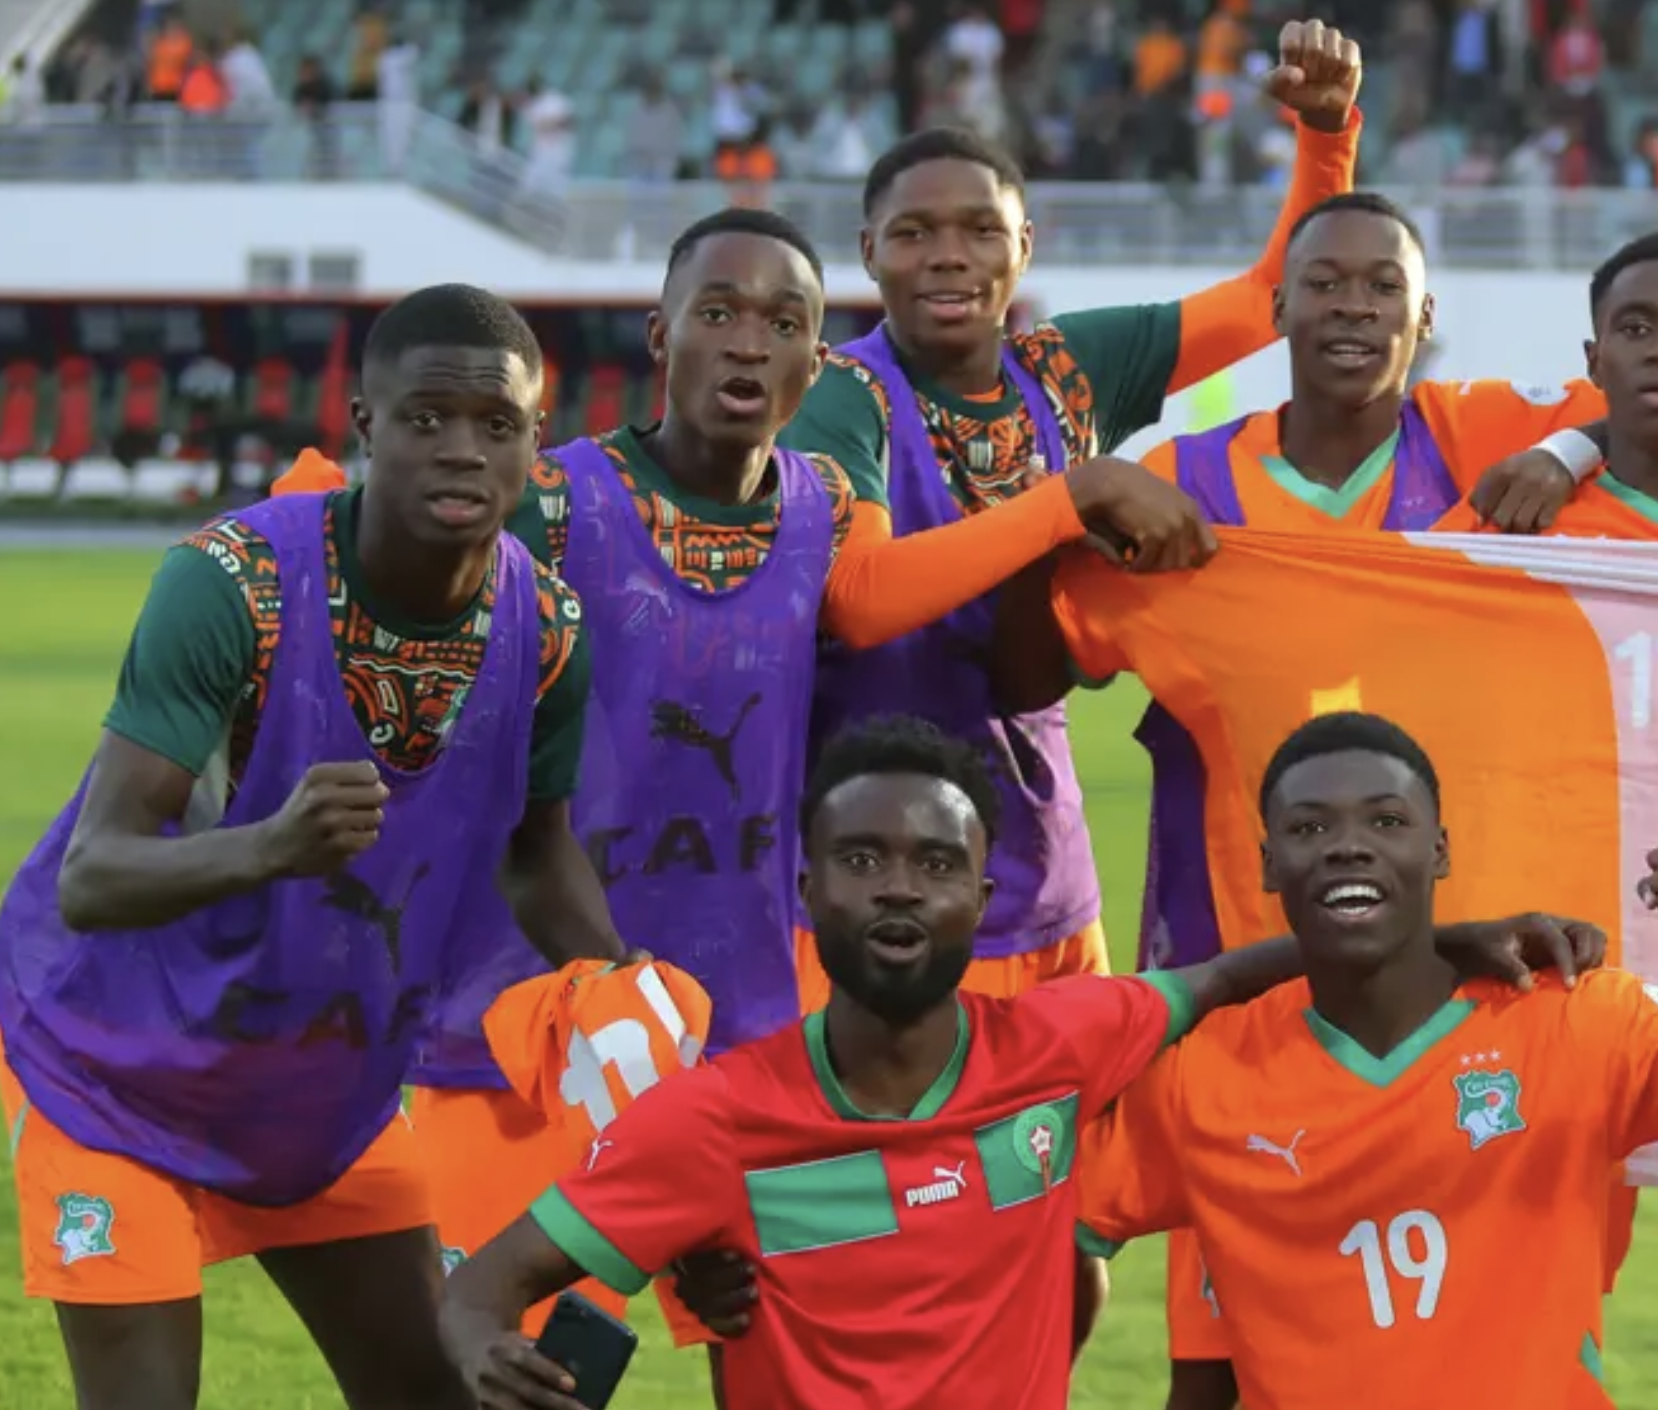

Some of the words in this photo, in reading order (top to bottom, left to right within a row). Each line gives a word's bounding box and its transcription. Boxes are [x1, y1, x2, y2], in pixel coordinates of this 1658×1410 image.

[587, 815, 776, 888] CAF
[905, 1180, 959, 1208] PUMA
[1338, 1209, 1449, 1329] 19
